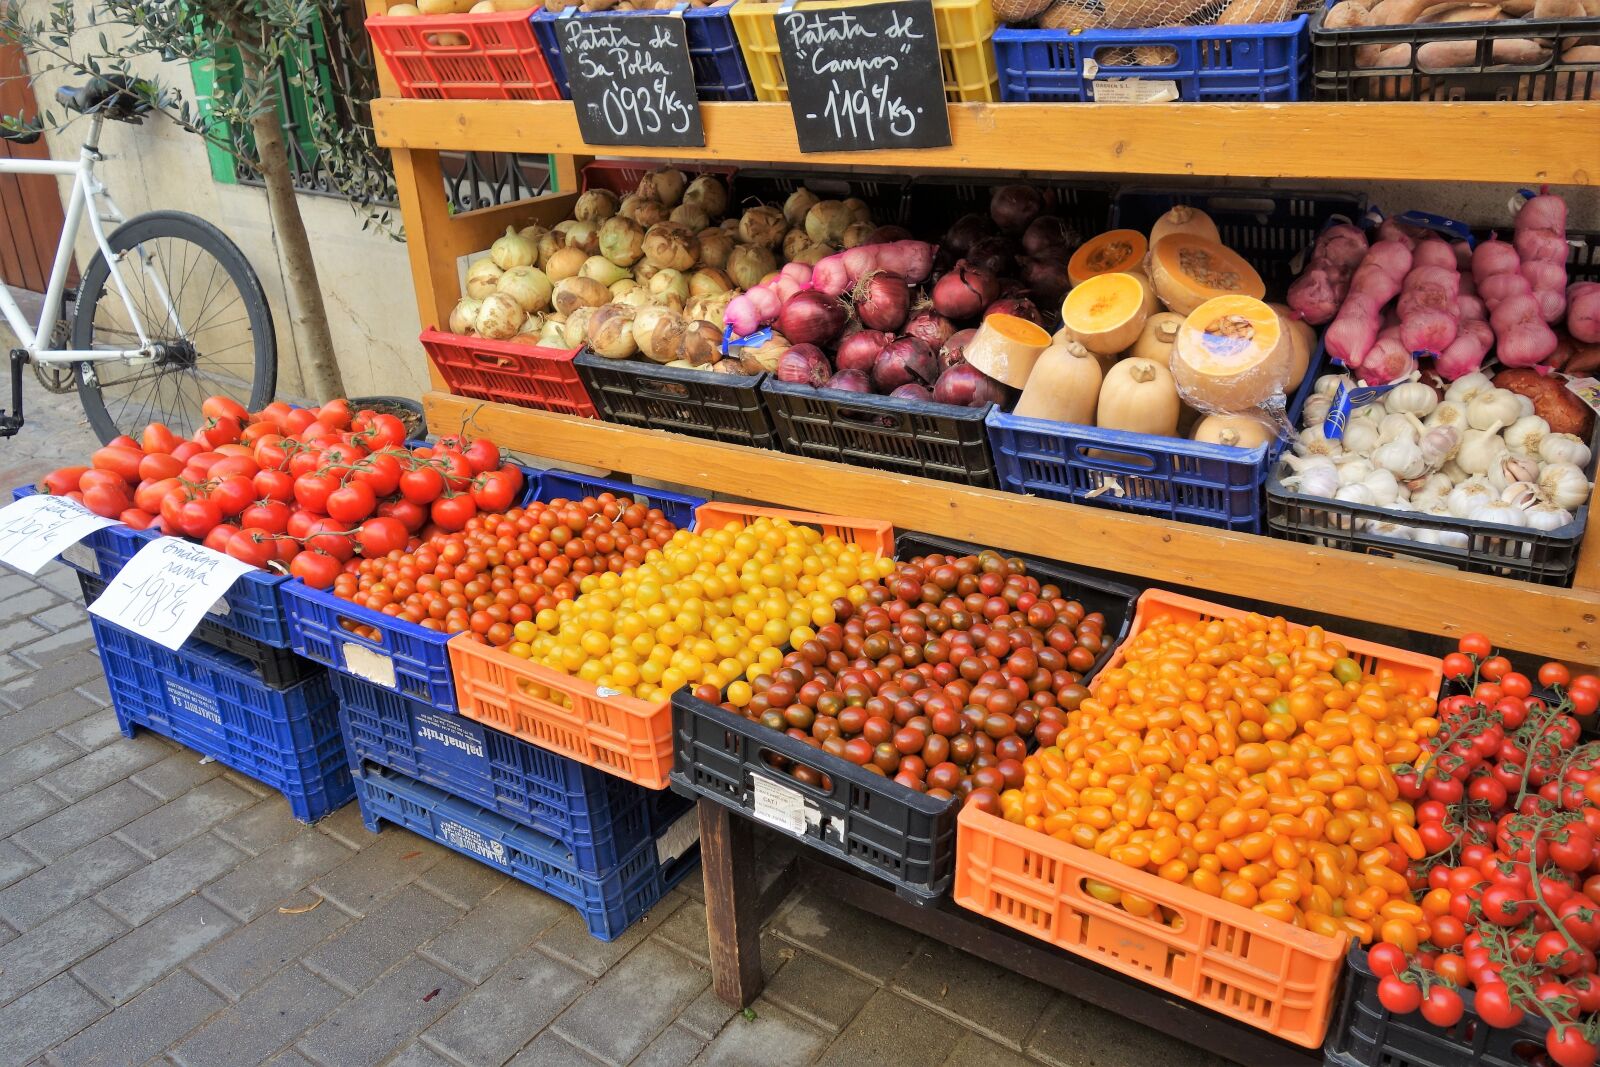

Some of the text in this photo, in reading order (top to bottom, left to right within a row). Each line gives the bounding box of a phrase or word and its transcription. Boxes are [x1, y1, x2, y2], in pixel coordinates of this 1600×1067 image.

[649, 24, 678, 48] de
[784, 10, 924, 49] Patata de
